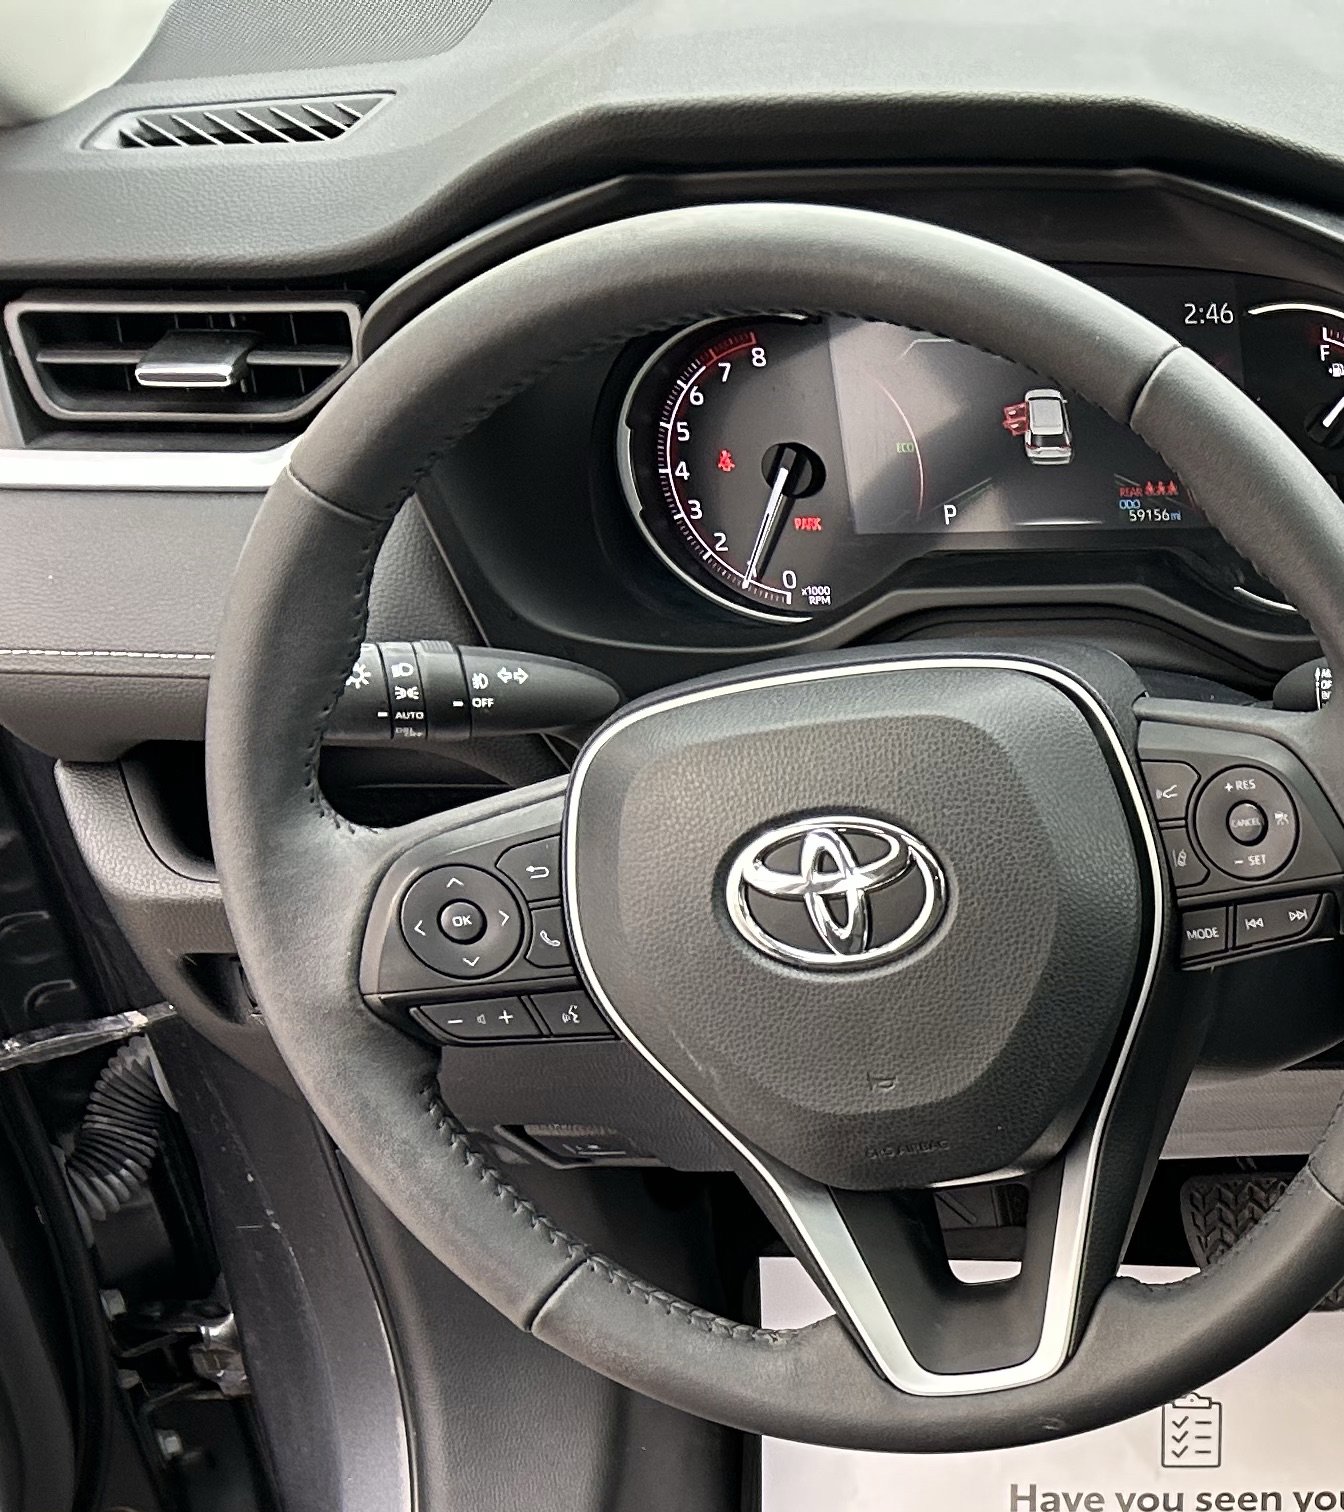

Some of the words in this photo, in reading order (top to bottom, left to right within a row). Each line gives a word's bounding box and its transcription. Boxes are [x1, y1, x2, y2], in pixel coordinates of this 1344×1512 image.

[1184, 302, 1234, 324] 2:46
[751, 348, 767, 367] 8
[1320, 345, 1330, 361] F
[718, 363, 731, 382] 7
[689, 386, 704, 406] 6
[676, 422, 690, 441] 5
[896, 441, 915, 453] ECO
[675, 461, 690, 480] 4
[687, 500, 702, 520] 3
[1119, 499, 1141, 510] ODO
[943, 504, 957, 525] P
[1129, 509, 1170, 522] 59156
[713, 533, 728, 551] 2
[782, 570, 797, 589] 0
[802, 586, 831, 596] x1000
[809, 596, 831, 605] RPM
[472, 698, 494, 709] OFF
[394, 711, 424, 720] AUTO
[1235, 779, 1256, 791] RES
[1247, 854, 1267, 866] SET
[452, 915, 472, 927] OK
[1186, 927, 1219, 940] MODE
[1011, 1485, 1104, 1512] Have
[1196, 1492, 1281, 1511] seen
